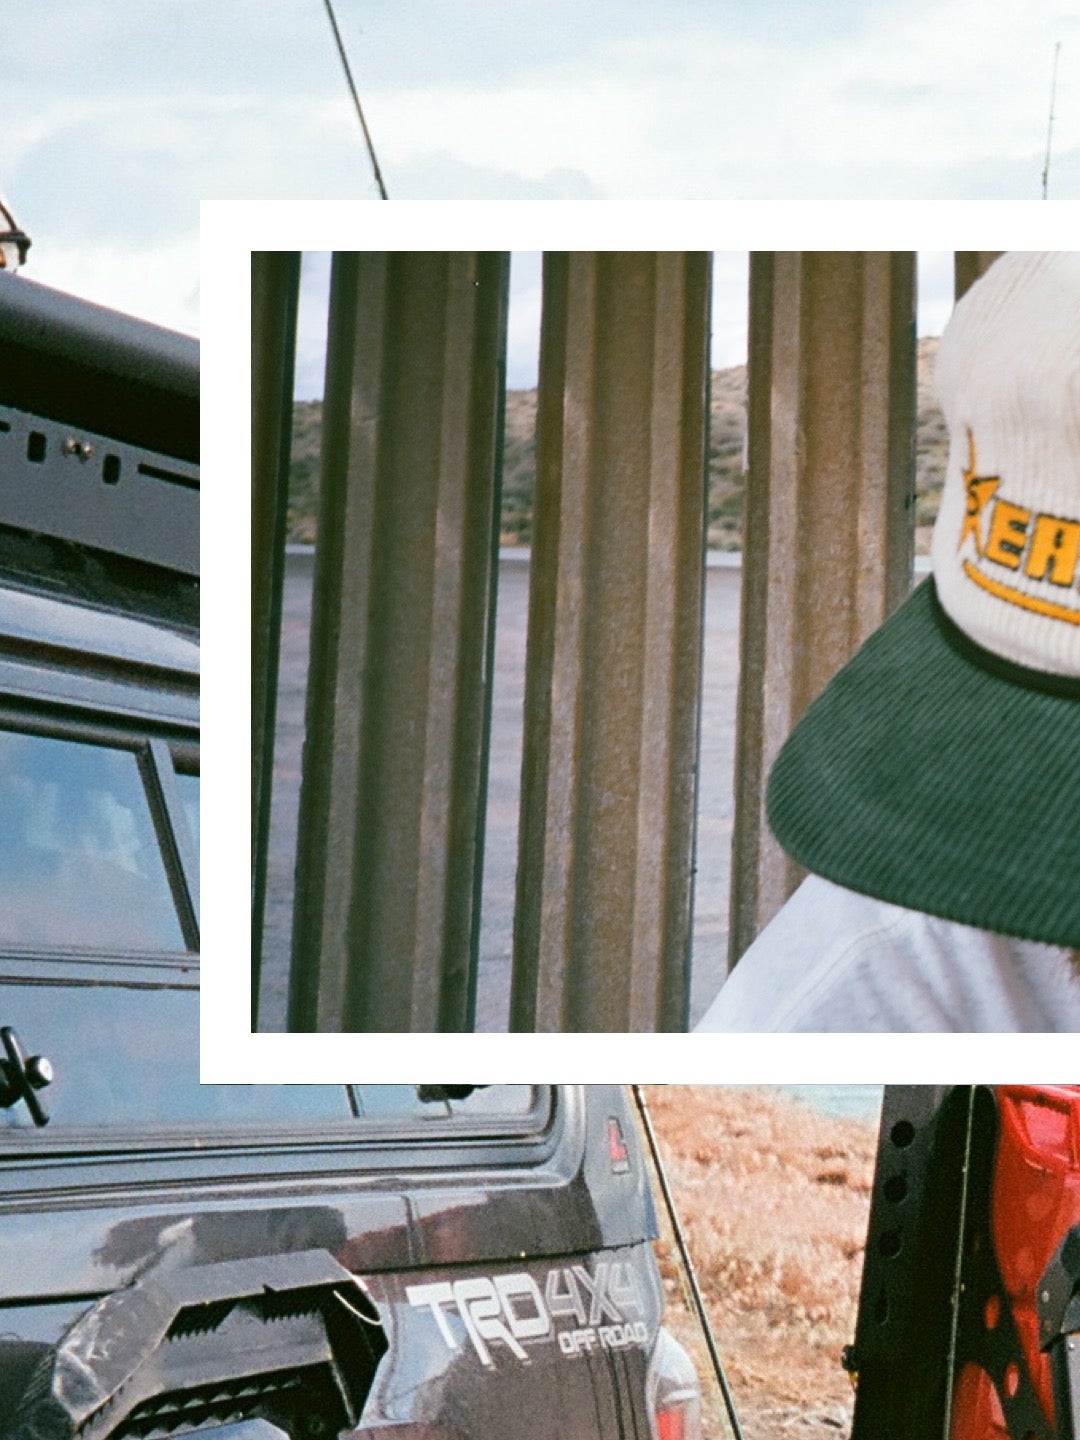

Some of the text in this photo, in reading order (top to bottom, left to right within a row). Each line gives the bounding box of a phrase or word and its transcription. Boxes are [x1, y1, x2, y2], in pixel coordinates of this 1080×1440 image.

[405, 1262, 646, 1368] TRD 4X4
[558, 1321, 648, 1355] OFF ROAD
